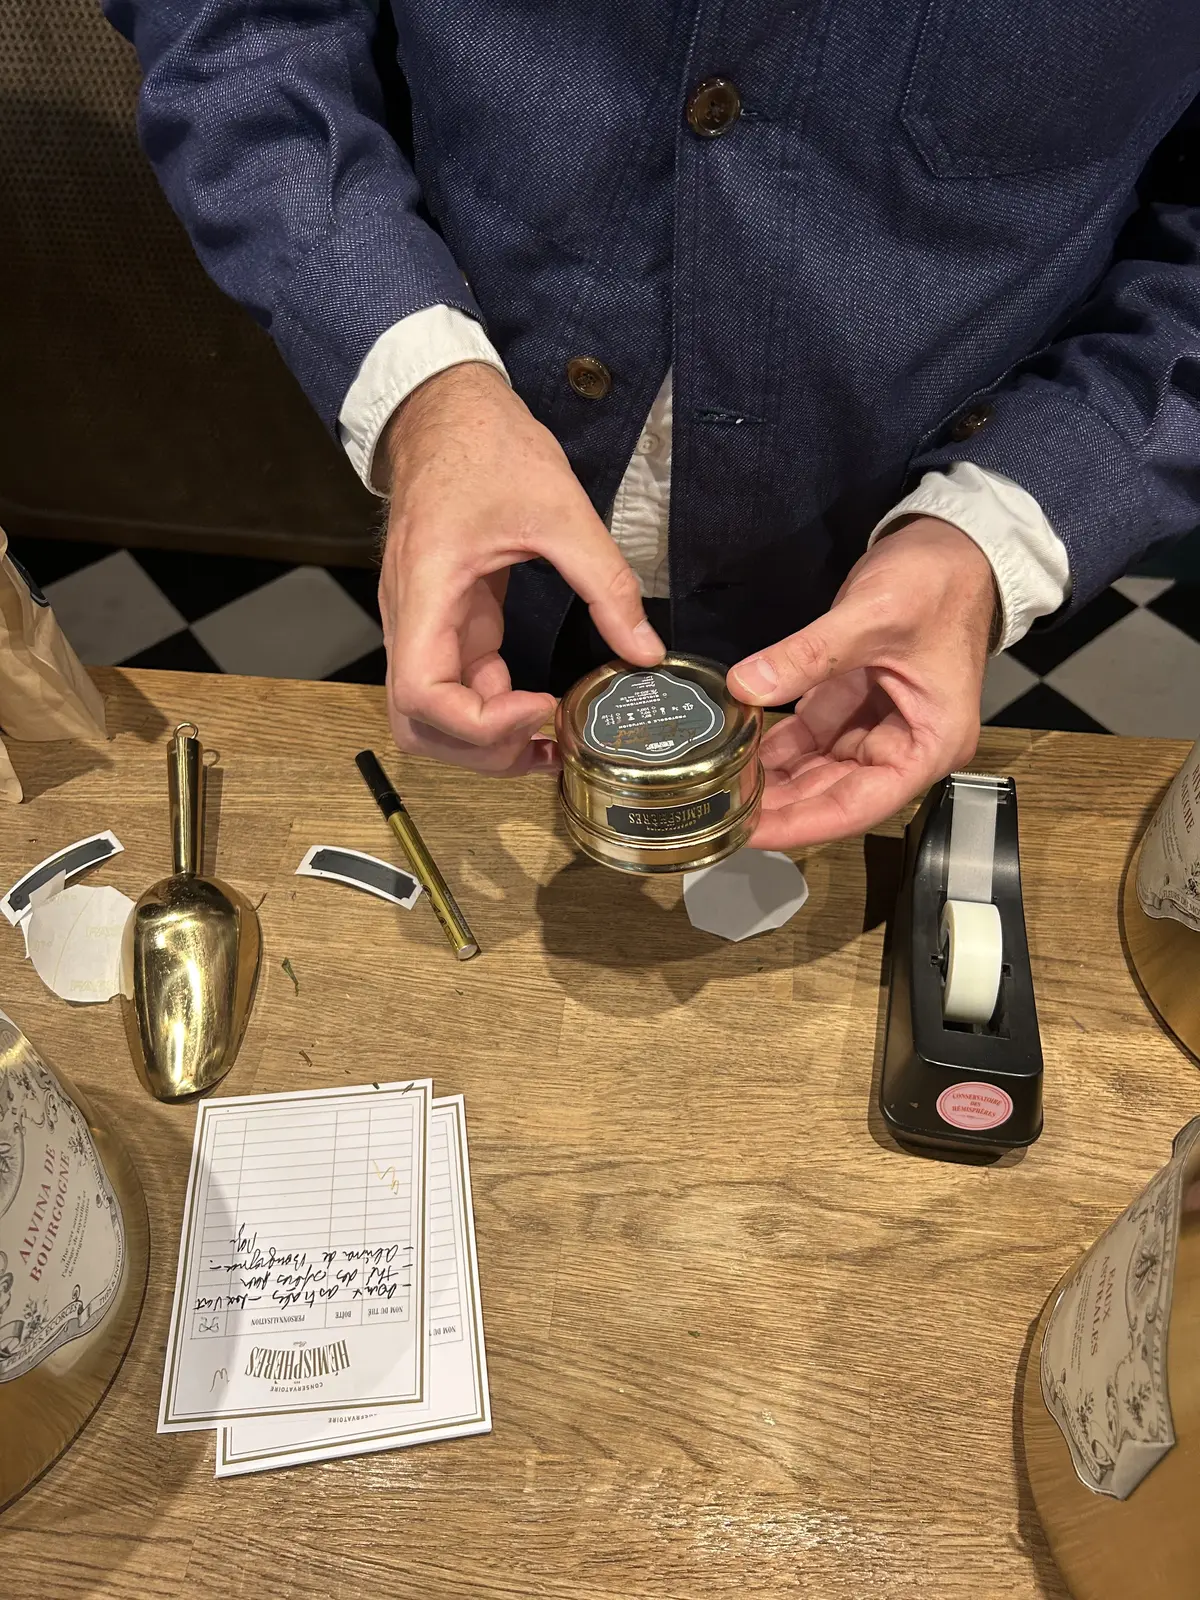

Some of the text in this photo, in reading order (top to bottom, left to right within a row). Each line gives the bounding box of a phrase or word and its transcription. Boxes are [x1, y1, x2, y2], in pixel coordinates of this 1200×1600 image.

[952, 1093, 1002, 1106] CONSERVATOIRE
[19, 1144, 56, 1266] ALVINA DE
[29, 1152, 70, 1283] BOURGOGNE
[1102, 1266, 1116, 1322] EAUX
[368, 1306, 404, 1316] NOM DU THÉ
[1090, 1255, 1110, 1357] ASTRALES
[250, 1314, 306, 1326] PERSONNALISATION
[433, 1328, 442, 1336] DU
[442, 1325, 456, 1334] NOM
[244, 1339, 350, 1384] HÉMISPHÈRES
[270, 1382, 324, 1392] CONSERVATOIRE
